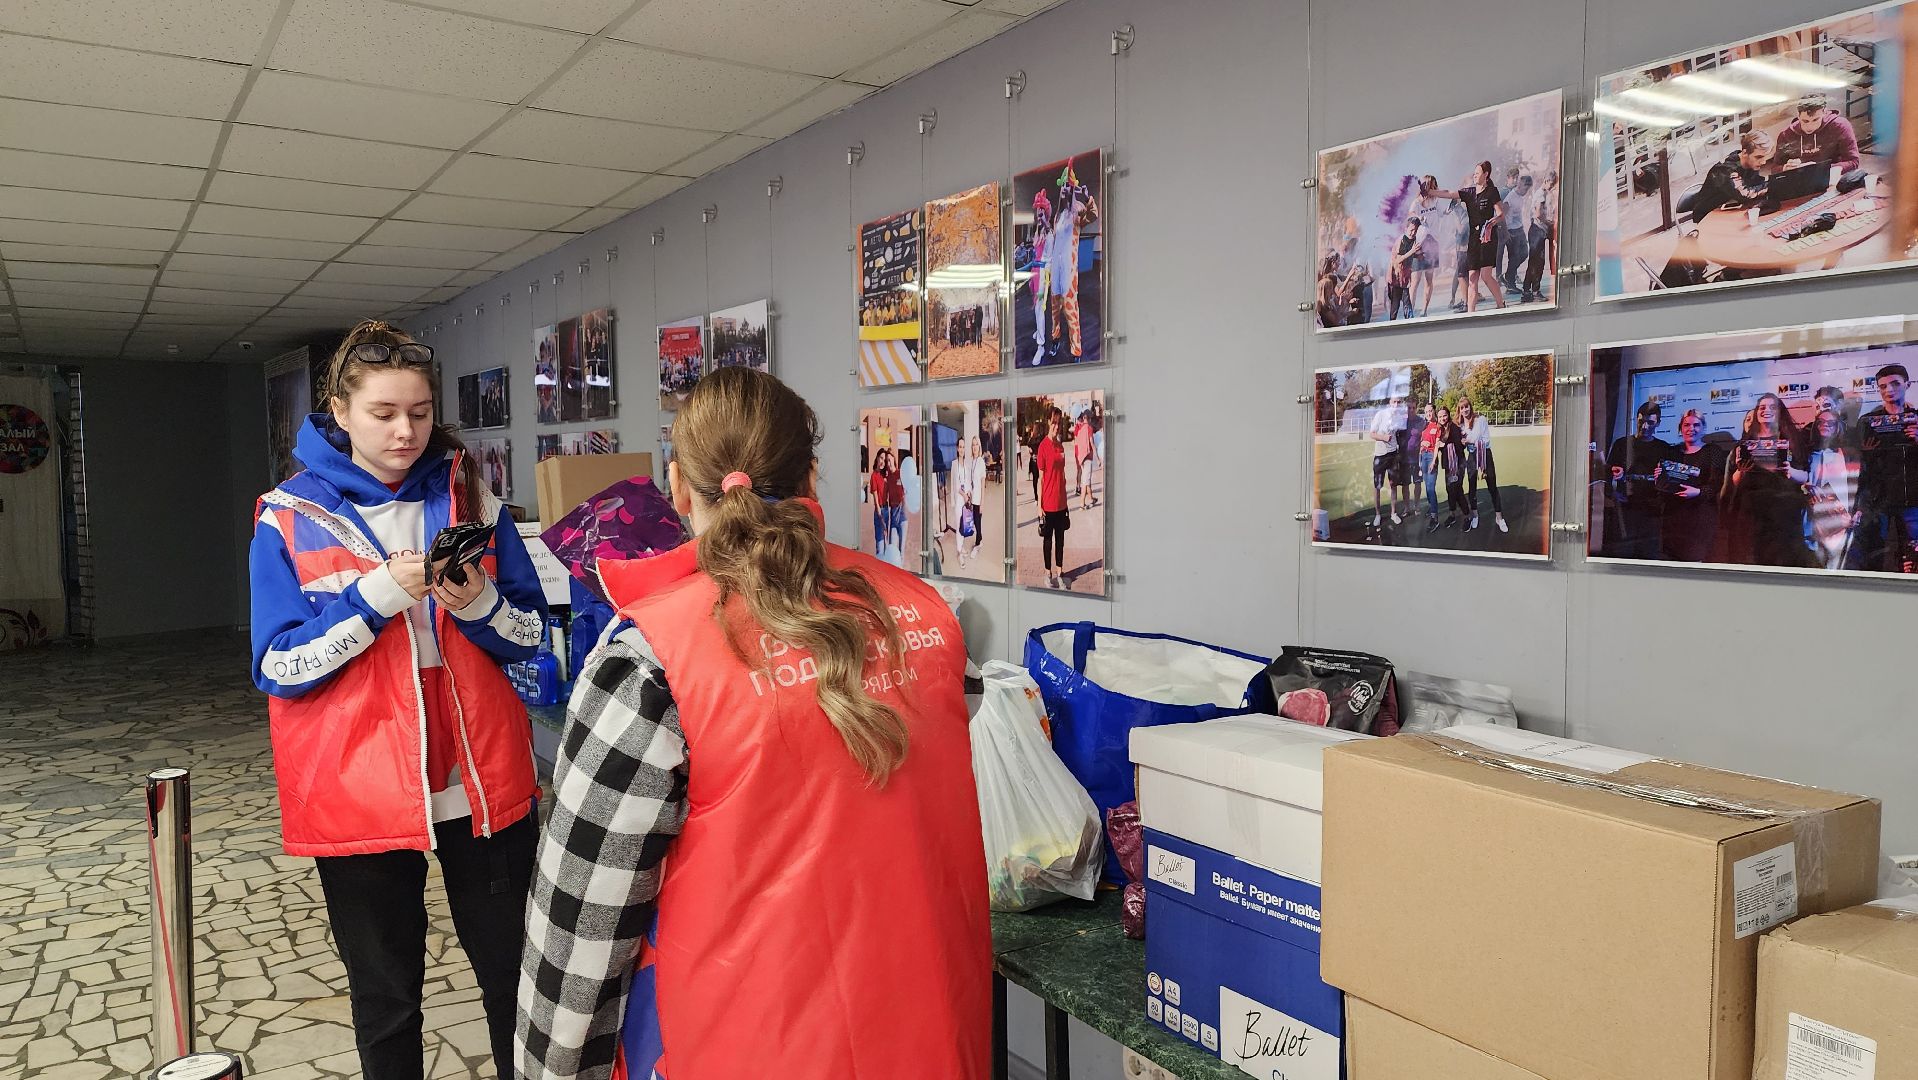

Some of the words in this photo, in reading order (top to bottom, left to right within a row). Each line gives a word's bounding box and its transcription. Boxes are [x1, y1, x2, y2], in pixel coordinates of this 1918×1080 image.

[1212, 871, 1247, 895] Ballet.
[1249, 884, 1284, 908] Paper
[1241, 897, 1266, 914] Бумага
[1267, 908, 1289, 922] имеет
[1233, 1009, 1314, 1063] Ballet
